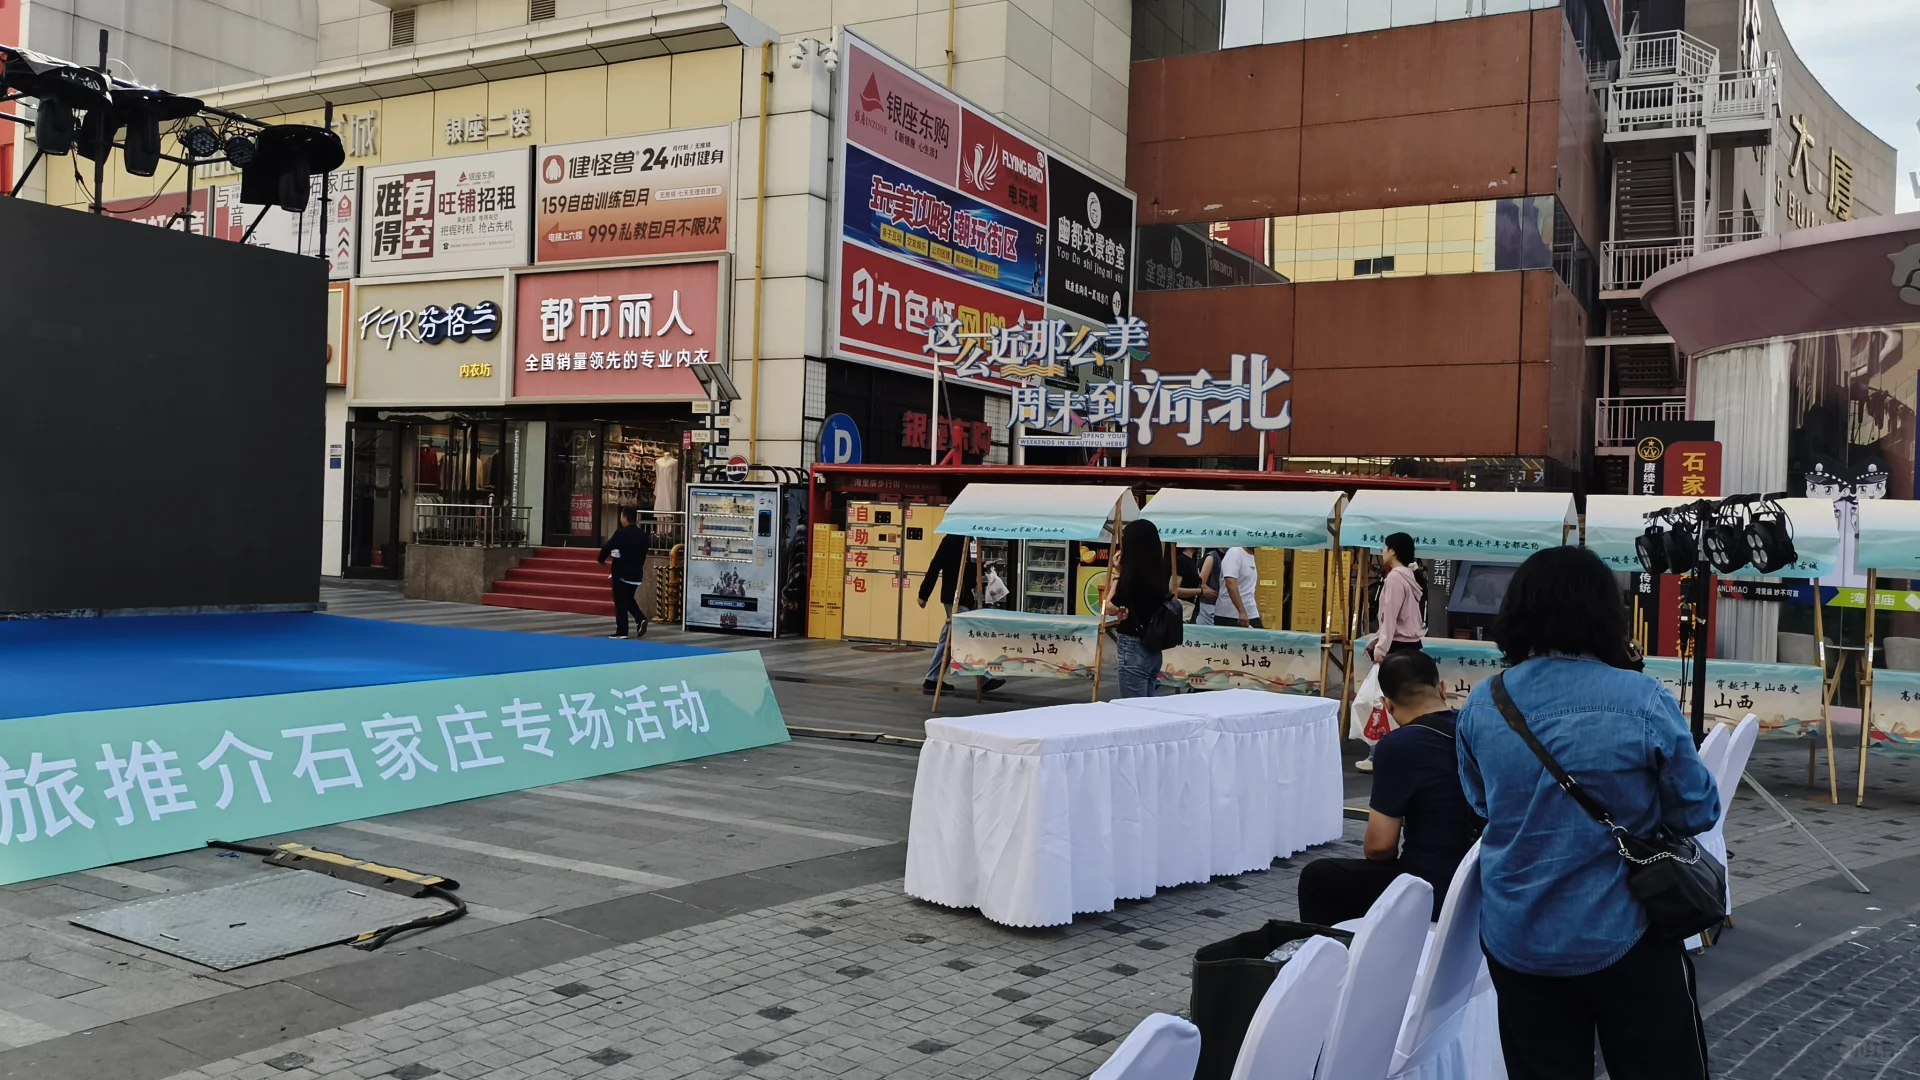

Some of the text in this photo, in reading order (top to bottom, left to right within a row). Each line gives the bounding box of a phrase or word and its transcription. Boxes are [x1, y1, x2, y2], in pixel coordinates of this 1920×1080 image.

[444, 108, 531, 146] 银座二楼
[886, 90, 950, 149] 银座东购
[468, 171, 496, 181] 银座东购
[568, 146, 724, 179] 健怪兽 24 小时健身
[1002, 149, 1028, 176] FLYING
[1027, 164, 1044, 184] BIRD
[1788, 114, 1853, 222] 大厦
[438, 185, 517, 216] 旺铺招租
[541, 188, 650, 215] 159自由训练包月
[1008, 184, 1039, 213] 电玩城
[1787, 189, 1827, 229] BUIL
[440, 220, 514, 237] 把握时机 抢占先机
[588, 215, 723, 243] 999私教包月不限次
[869, 175, 1019, 262] 玩美攻略 潮玩街区
[1035, 232, 1044, 245] 5F
[1058, 215, 1126, 271] 幽都实景密室
[418, 301, 501, 343] 芬格兰
[540, 290, 694, 343] 都市丽人
[922, 314, 1150, 379] 这么近那么美
[459, 362, 492, 378] 内衣坊
[853, 506, 868, 593] 自助存包
[1448, 538, 1540, 550] 邀您共赴千年古都之约
[1639, 572, 1652, 594] 传统
[1774, 589, 1800, 598] 妙不可言
[968, 630, 1084, 645] 高铁向西一小时 穿越千年山西史
[1032, 642, 1059, 655] 山西
[1241, 644, 1305, 658] 穿越千年山西史
[1205, 654, 1272, 669] 下一站 山西
[1455, 678, 1471, 694] 山
[1715, 679, 1801, 695] 穿越千年山西史
[1714, 692, 1754, 710] 山西
[0, 679, 711, 846] 旅推介石家庄专场活动
